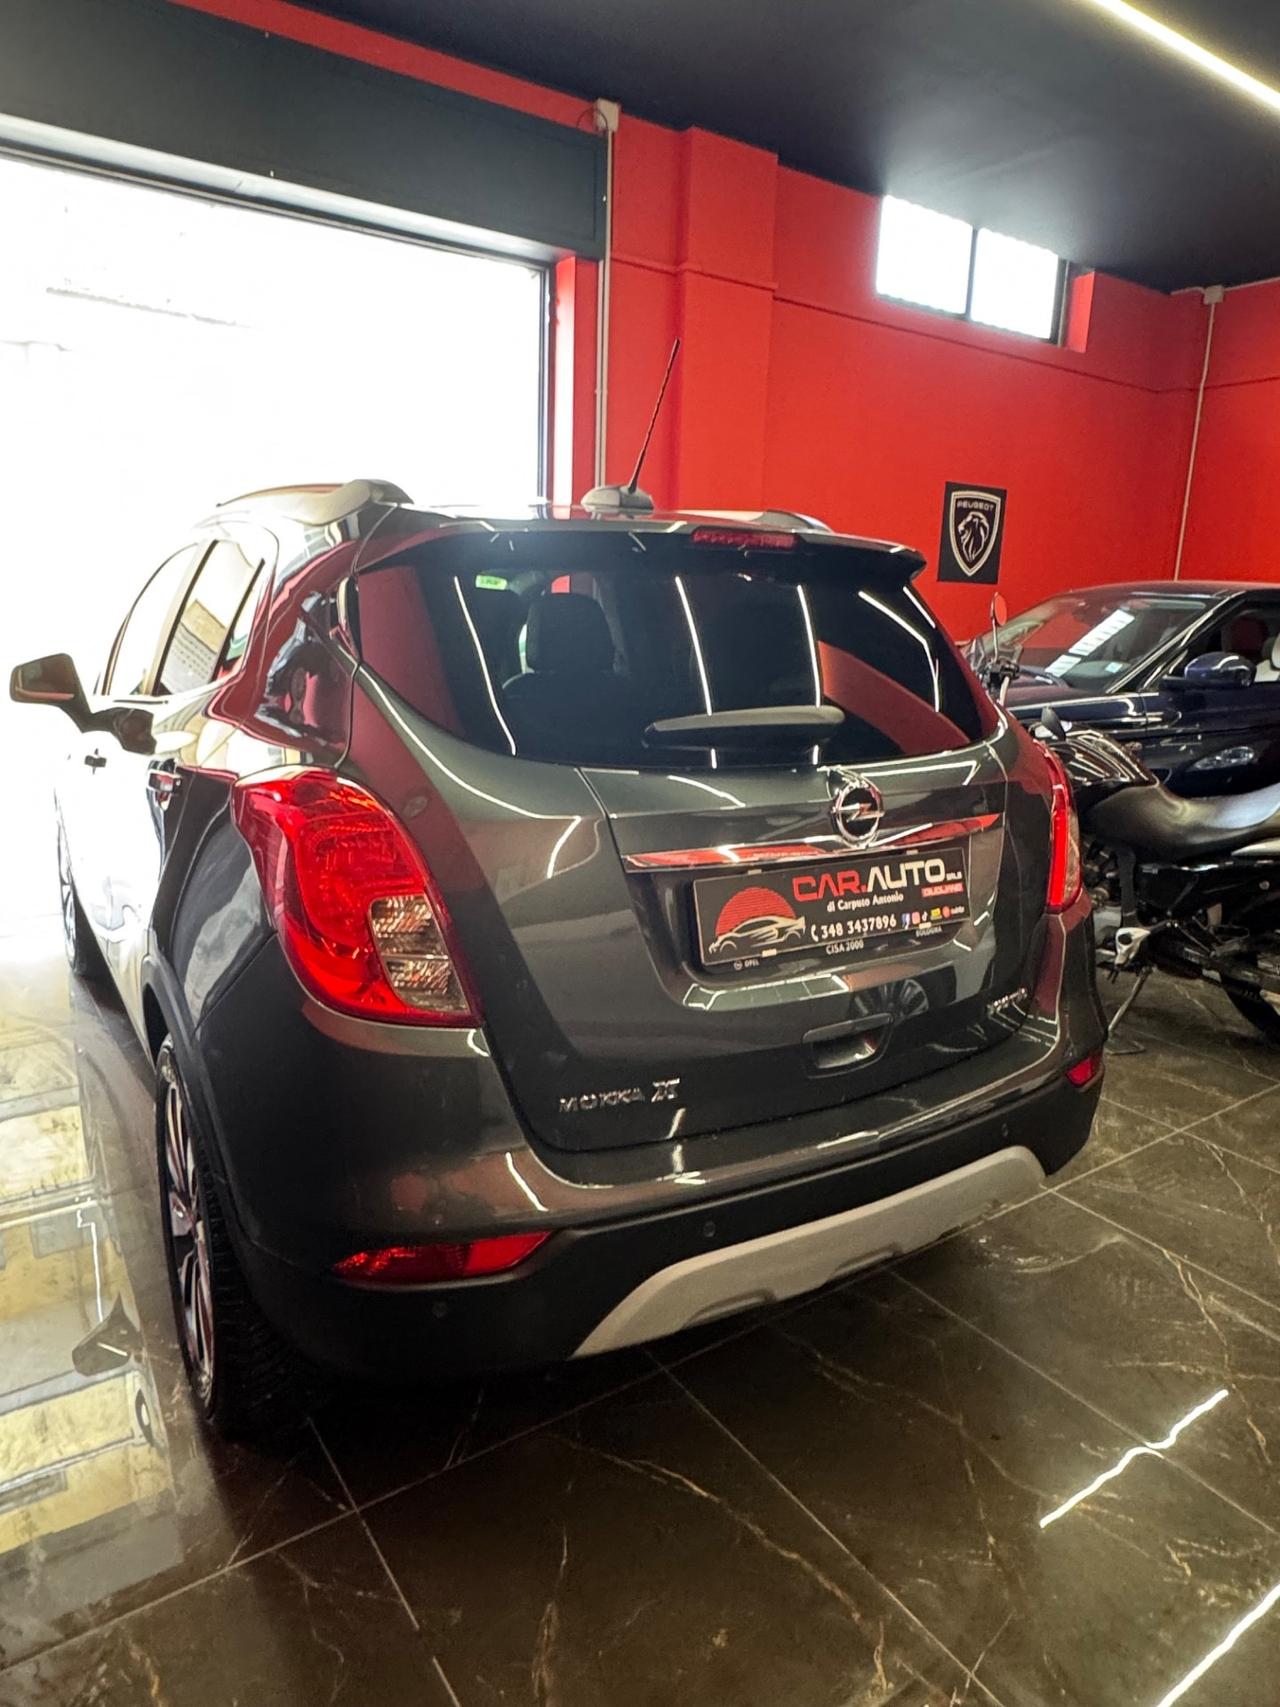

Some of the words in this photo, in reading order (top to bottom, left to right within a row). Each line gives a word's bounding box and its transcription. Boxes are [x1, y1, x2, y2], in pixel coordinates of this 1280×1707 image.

[956, 501, 995, 512] PEUGEOT
[827, 899, 835, 912] di
[837, 896, 871, 911] Carputo
[872, 891, 904, 906] Antonio
[821, 922, 844, 939] 348
[847, 914, 897, 933] 3437896
[826, 943, 845, 955] CISA
[846, 940, 864, 951] 2000
[744, 958, 760, 968] OPEL
[558, 1087, 645, 1113] MOKKA
